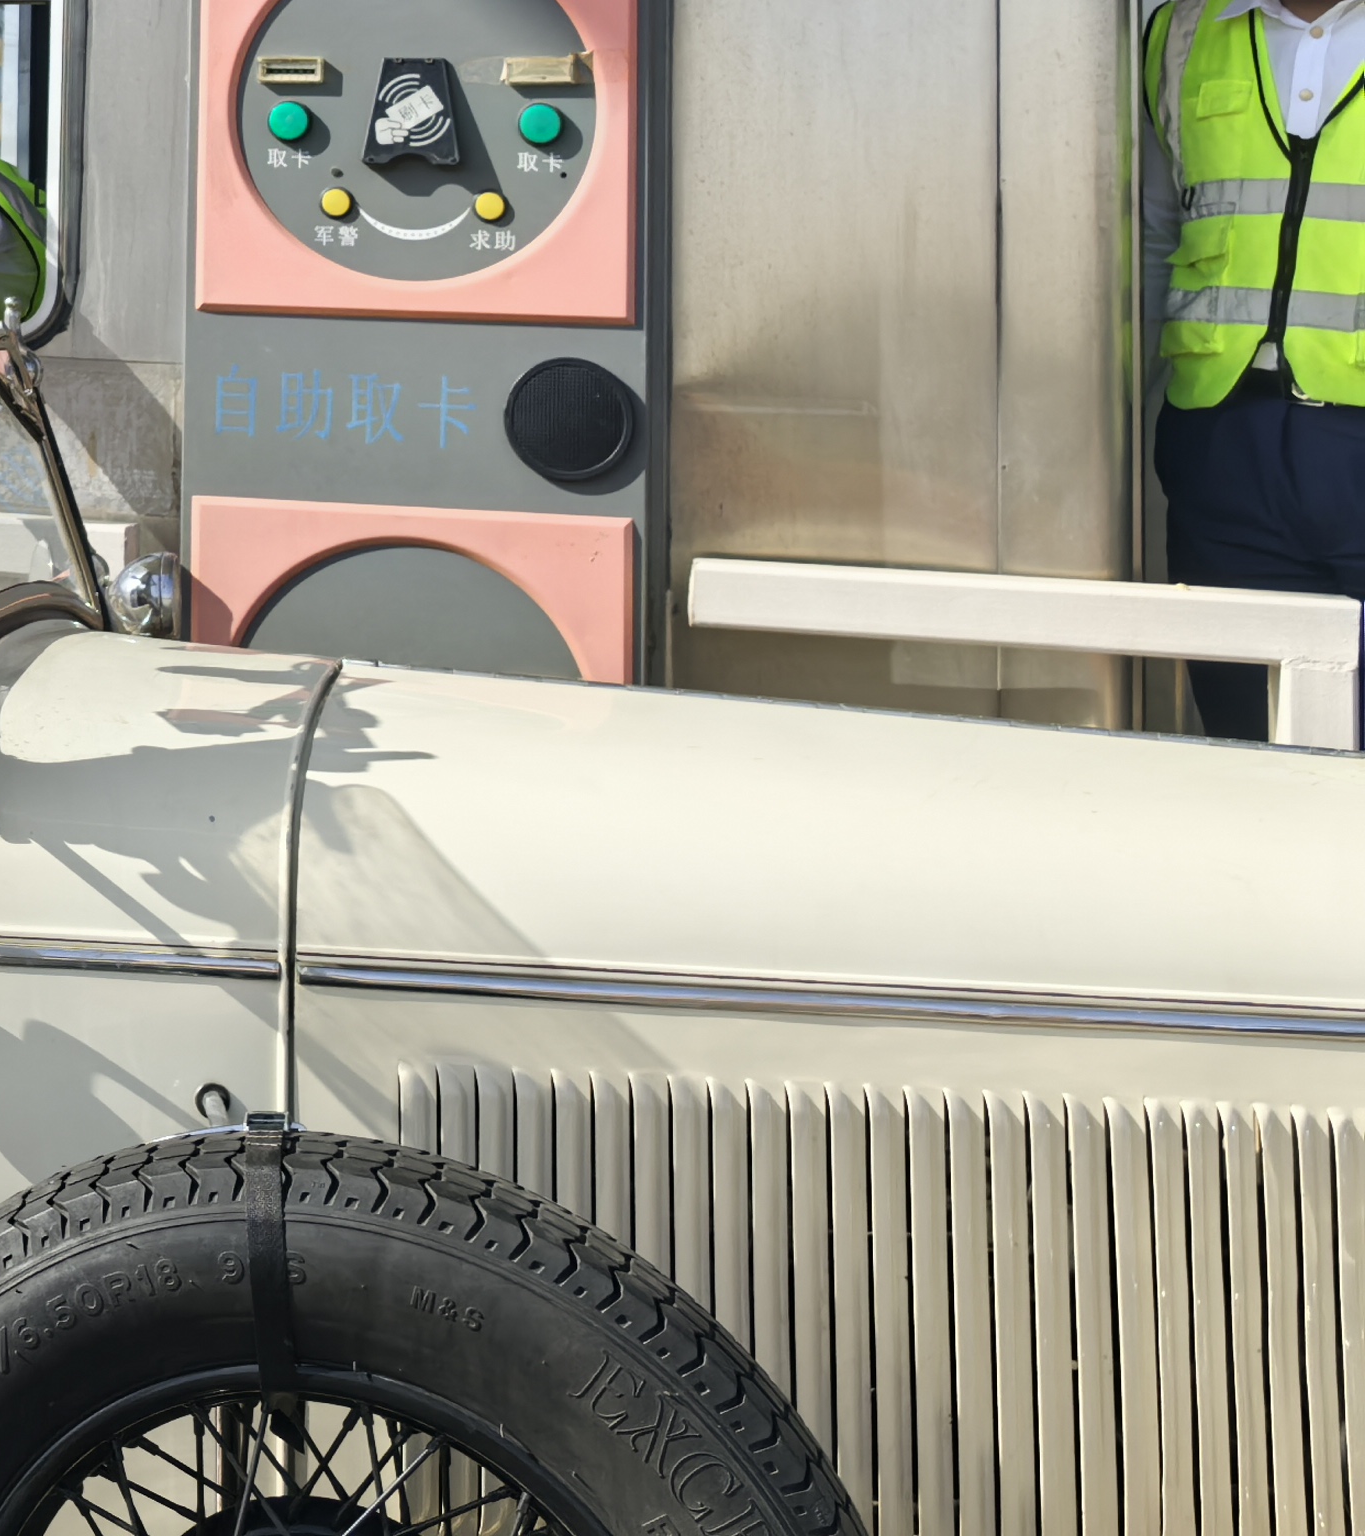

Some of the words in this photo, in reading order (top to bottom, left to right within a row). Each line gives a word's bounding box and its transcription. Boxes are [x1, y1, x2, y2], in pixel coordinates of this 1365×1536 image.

[267, 148, 312, 169] 取卡
[517, 152, 567, 173] 取卡
[314, 225, 359, 248] 军警
[469, 230, 517, 252] 求助
[214, 363, 478, 450] 自助取卡
[409, 1284, 486, 1333] M&S
